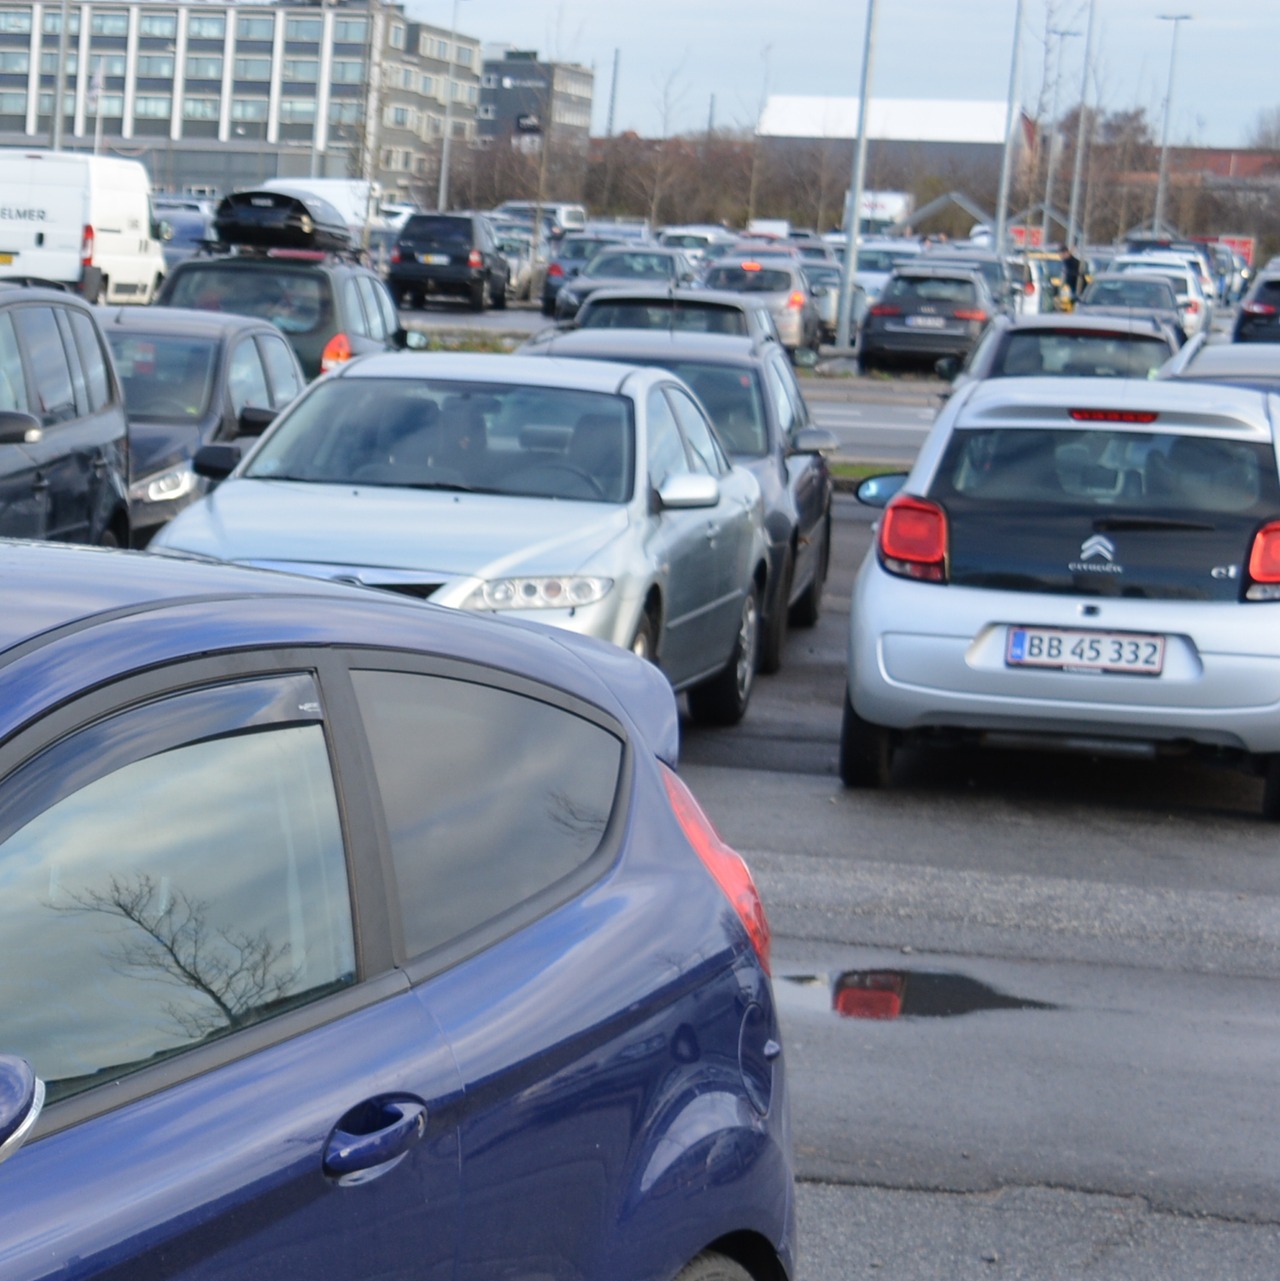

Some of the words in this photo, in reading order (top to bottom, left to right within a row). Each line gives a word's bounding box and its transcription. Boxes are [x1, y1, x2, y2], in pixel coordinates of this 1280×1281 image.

[0, 207, 47, 221] ELMER
[1027, 635, 1063, 659] BB
[1070, 638, 1101, 662] 45
[1108, 640, 1158, 666] 332
